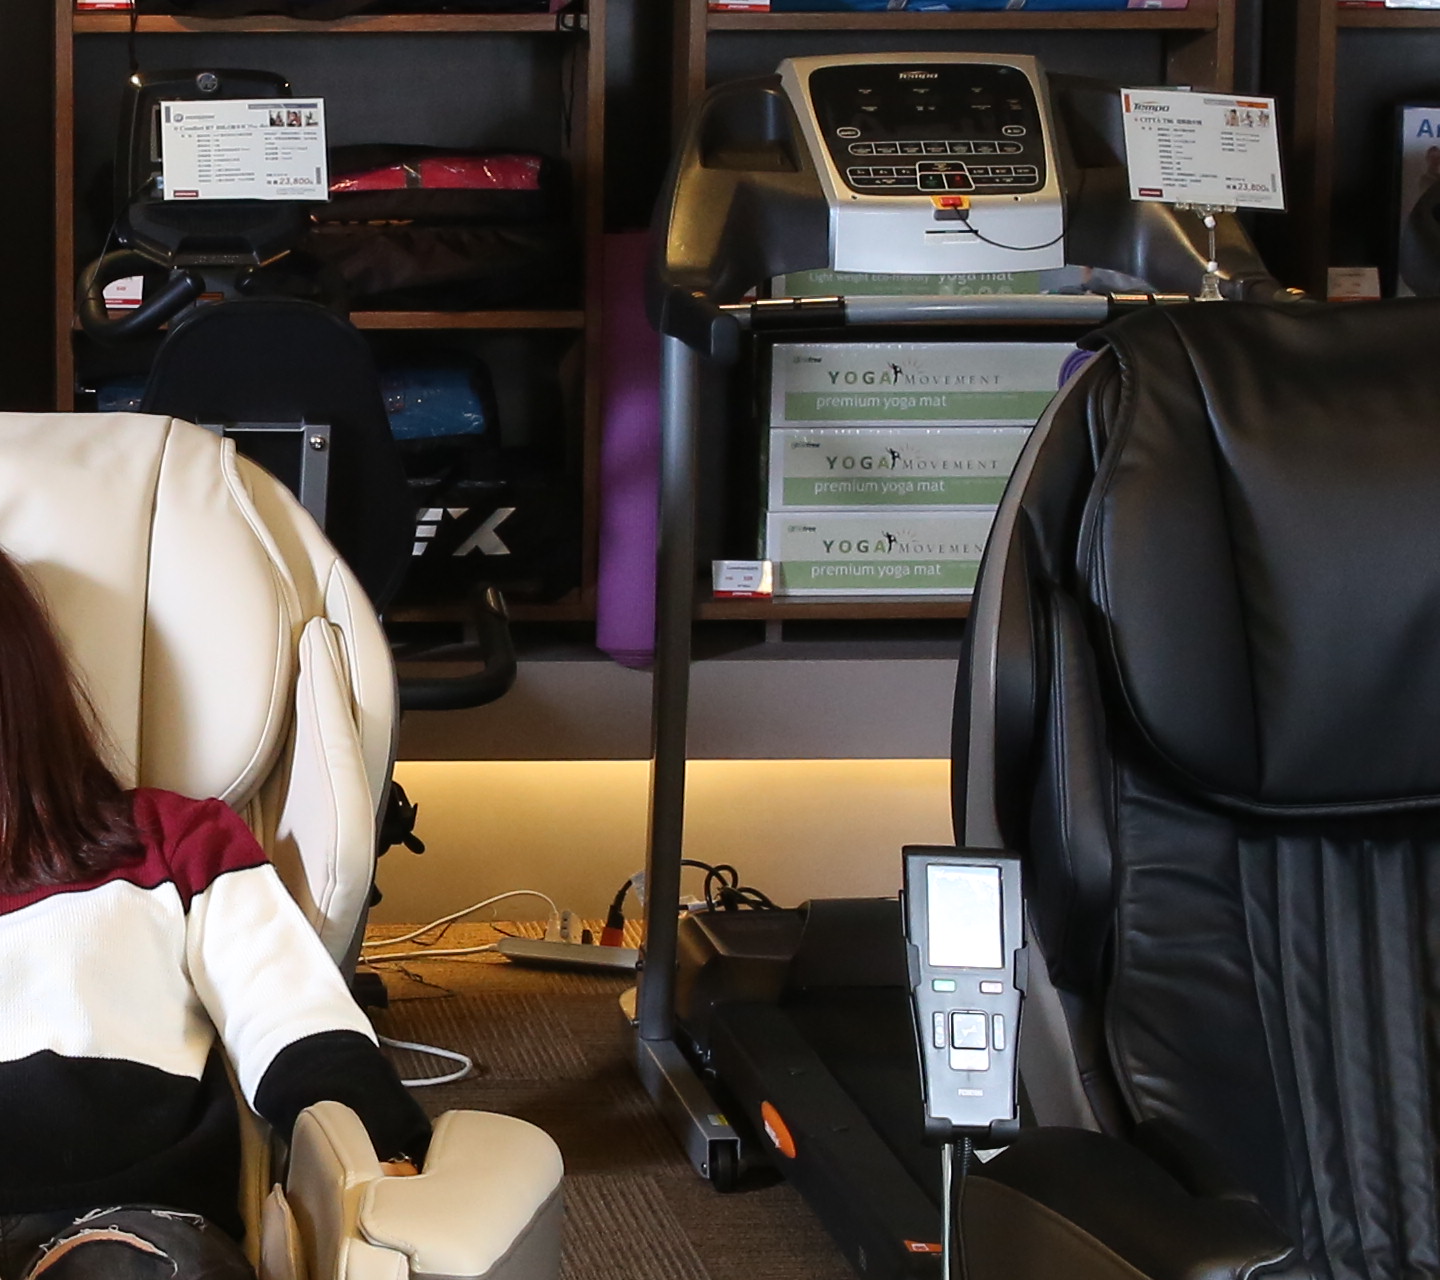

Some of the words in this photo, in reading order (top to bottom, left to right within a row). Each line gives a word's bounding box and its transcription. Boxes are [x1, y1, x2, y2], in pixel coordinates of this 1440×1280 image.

[828, 371, 893, 385] YOGA
[816, 396, 880, 410] premium
[884, 397, 916, 410] yoga
[920, 396, 947, 407] mat
[826, 456, 889, 470] YOGA
[814, 480, 878, 494] premium
[881, 481, 914, 495] yoga
[917, 480, 945, 492] mat
[823, 540, 886, 553] YOGA
[899, 544, 982, 554] MOVEMEN
[811, 564, 875, 578] premium
[877, 565, 910, 578] yoga
[914, 564, 941, 575] mat
